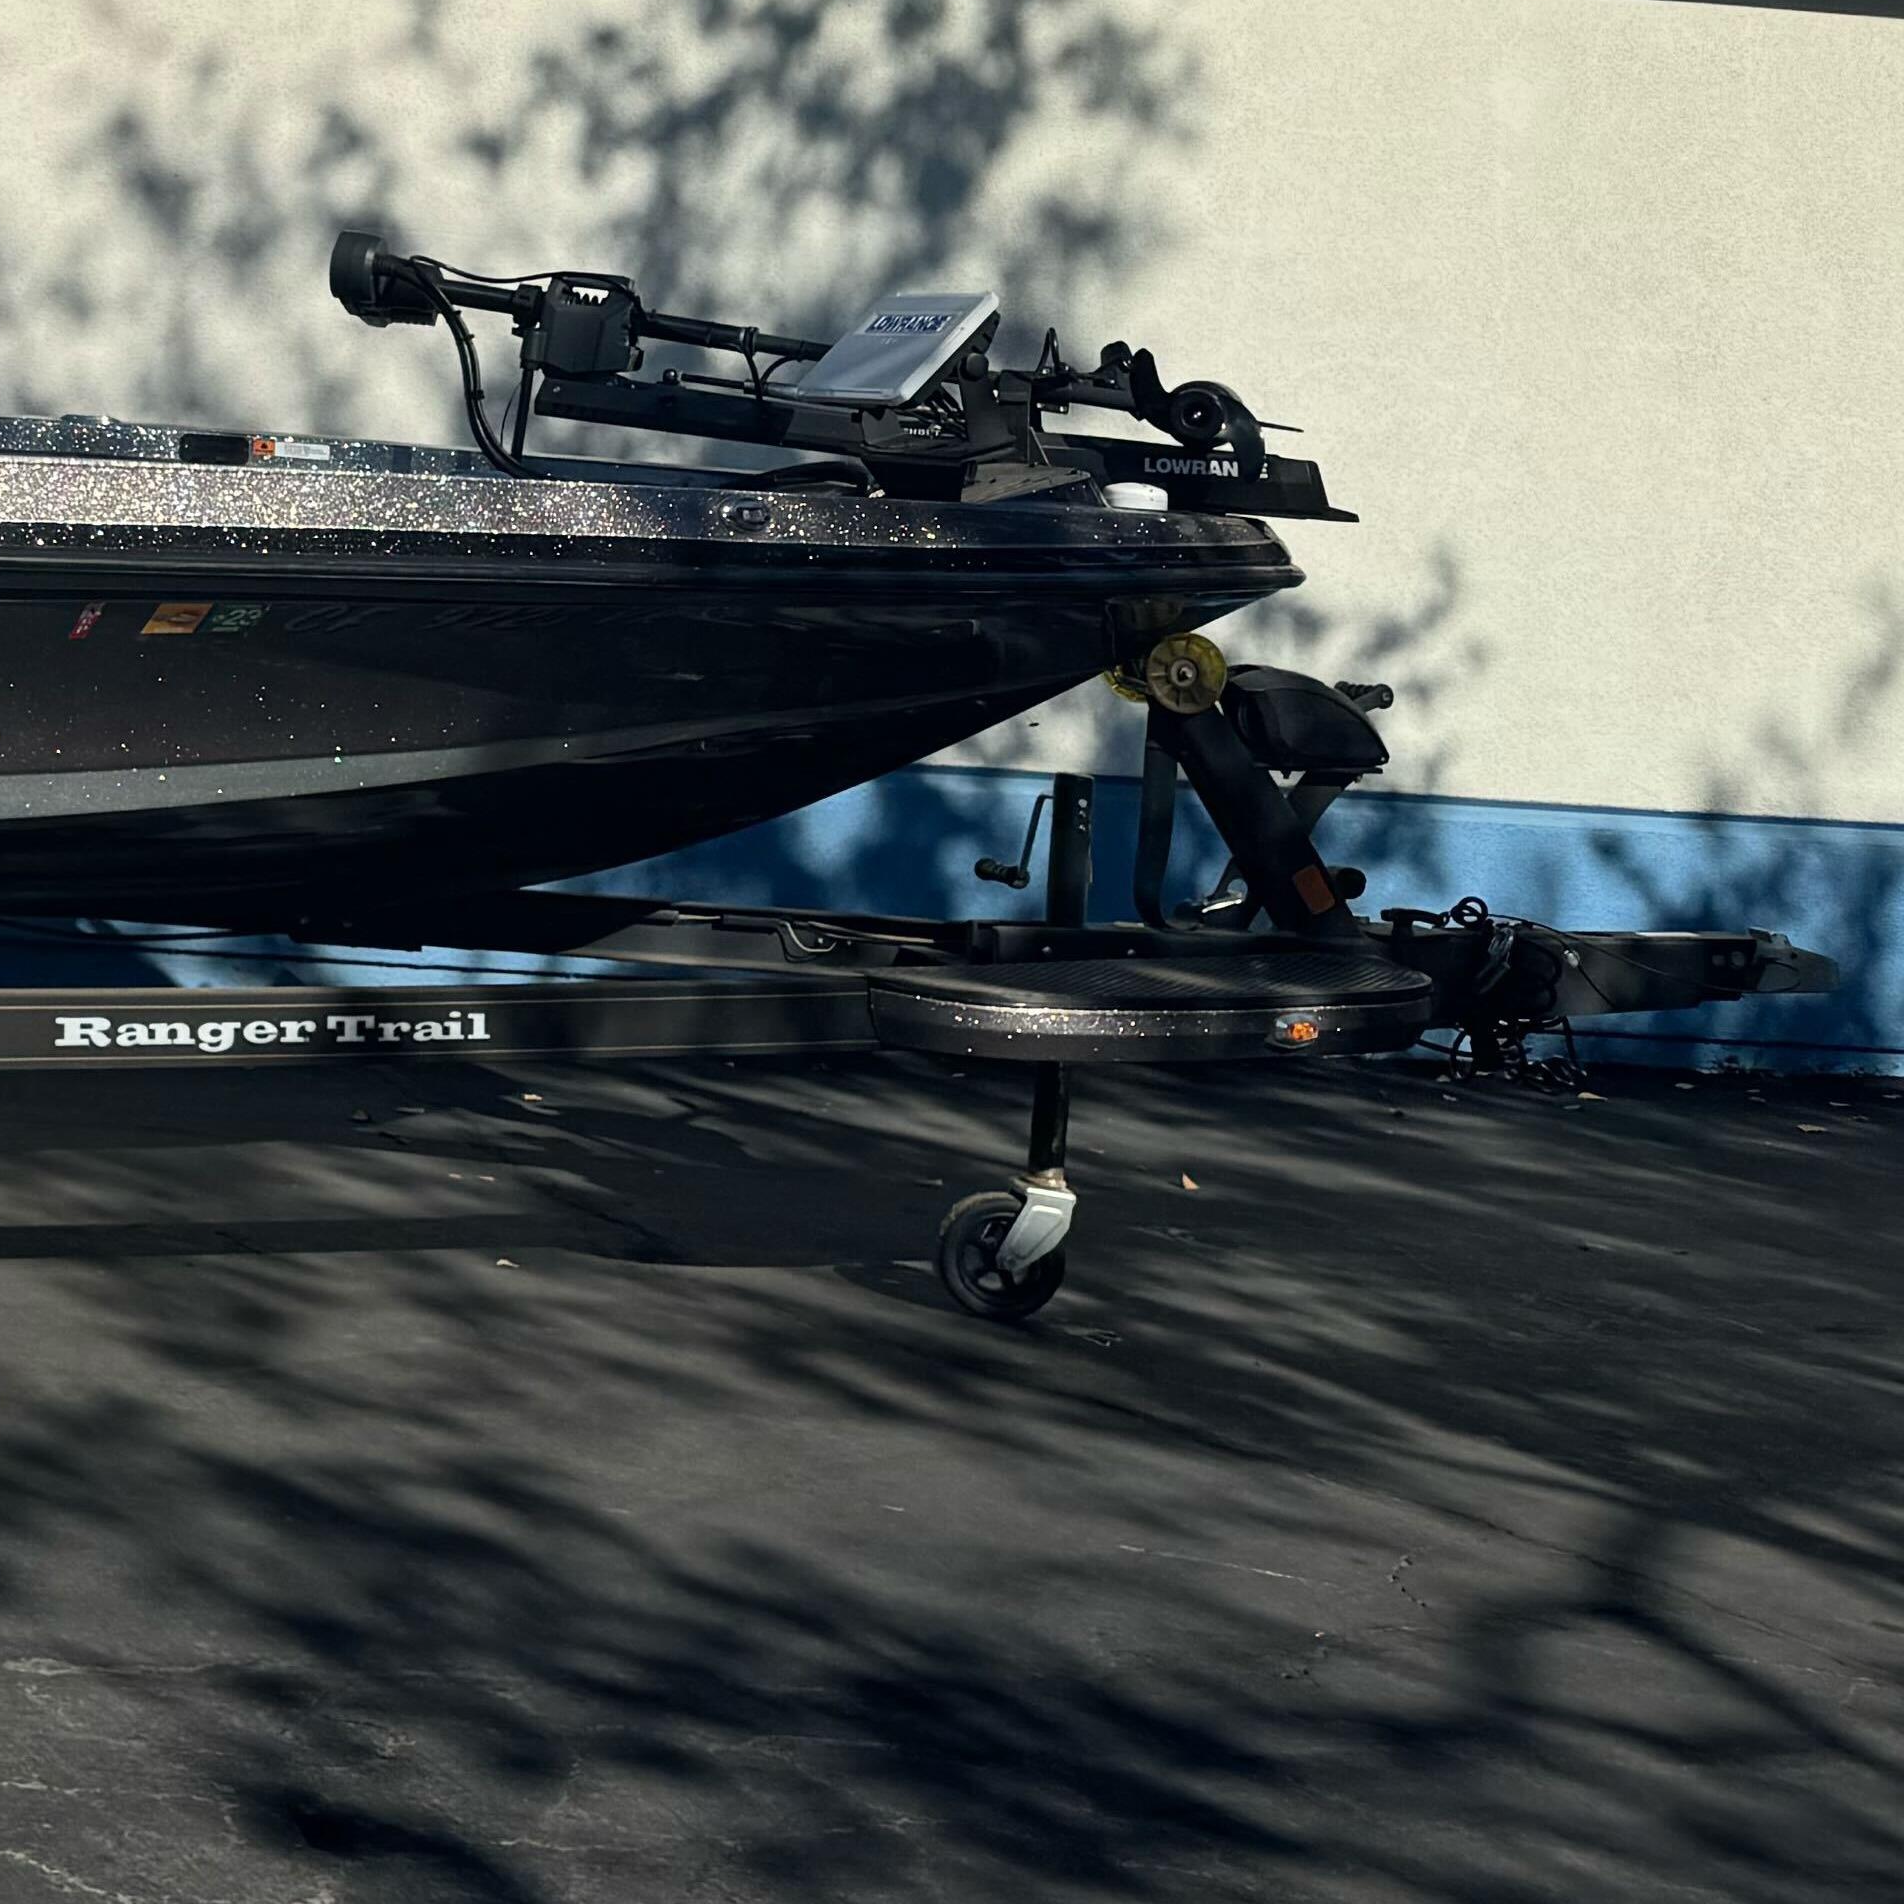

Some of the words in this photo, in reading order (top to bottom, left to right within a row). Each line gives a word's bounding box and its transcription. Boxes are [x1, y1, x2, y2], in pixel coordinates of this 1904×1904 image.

[1143, 457, 1269, 479] LOWRANE
[54, 1016, 317, 1053] Ranger
[326, 1010, 491, 1044] Trail
